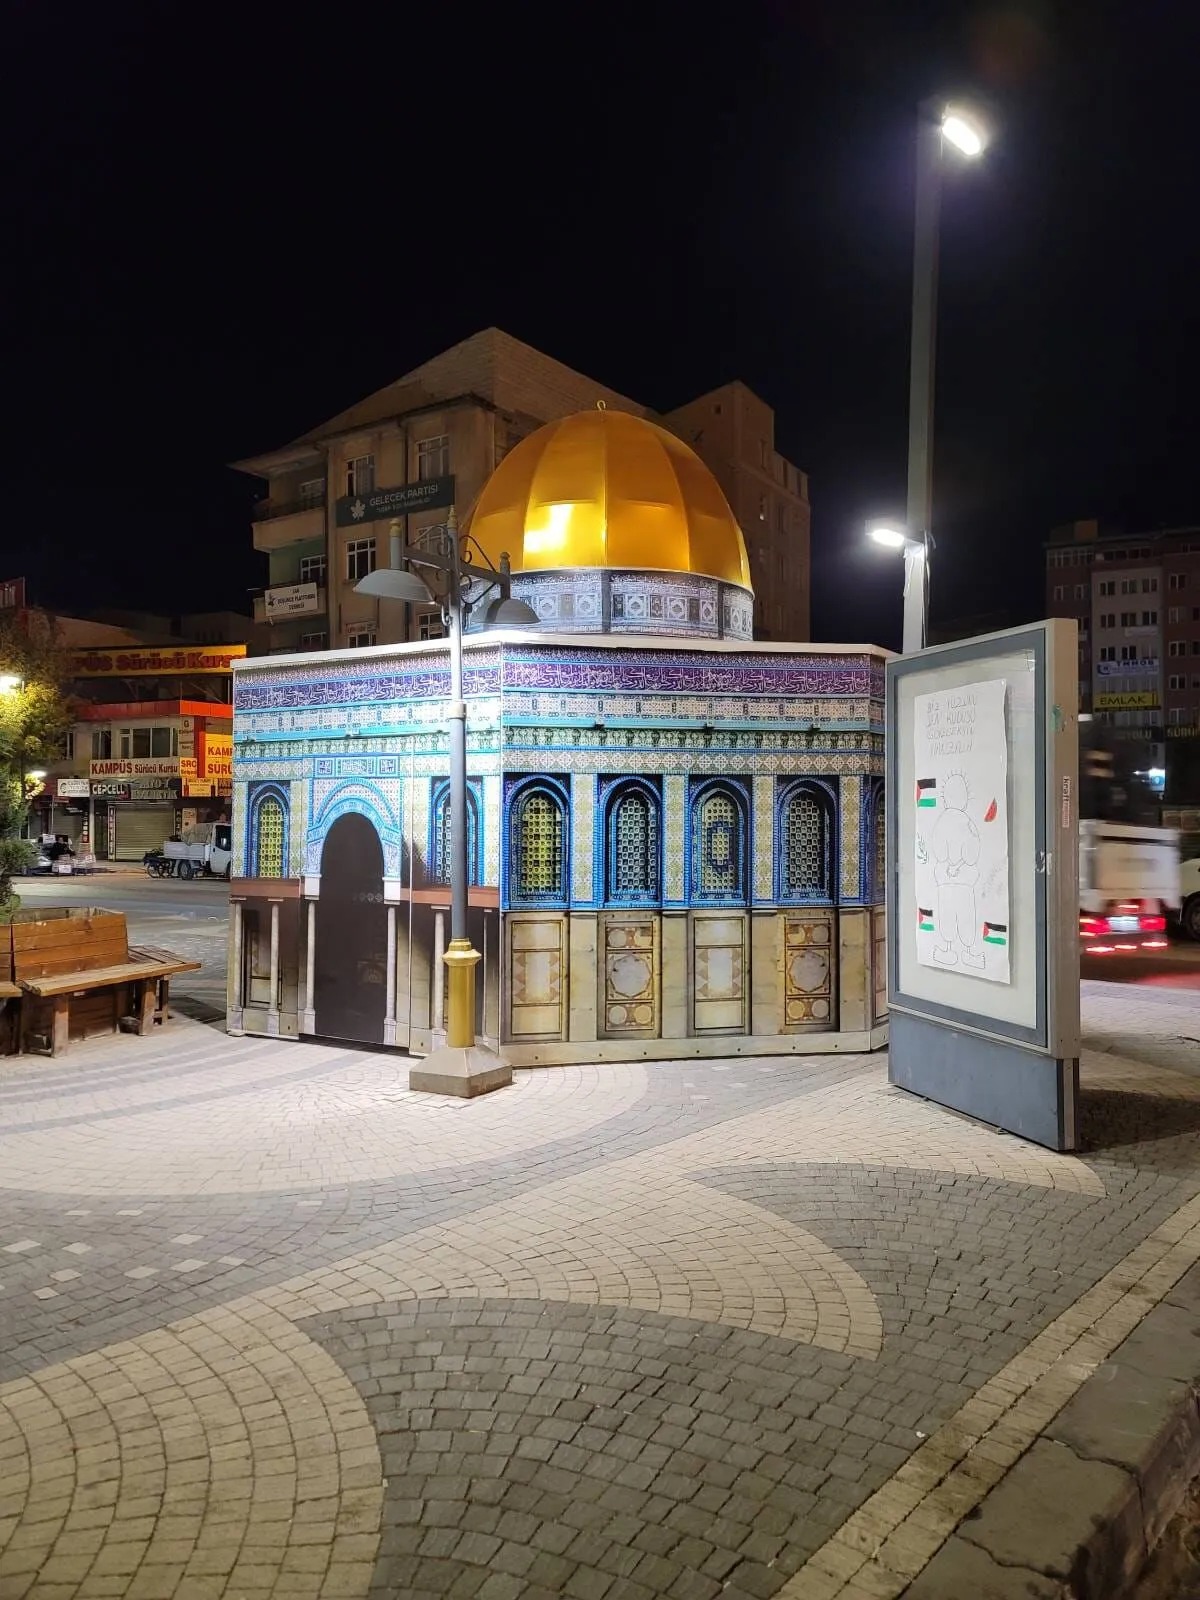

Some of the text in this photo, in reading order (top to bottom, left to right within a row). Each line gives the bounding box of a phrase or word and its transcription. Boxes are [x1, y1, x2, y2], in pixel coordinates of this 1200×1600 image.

[369, 491, 407, 506] GELECEK
[116, 651, 186, 671] Sürücü
[1100, 695, 1146, 705] EMLAK
[91, 760, 178, 775] KAMPÜS Sürücü Kursu
[92, 783, 126, 795] CEPCELL
